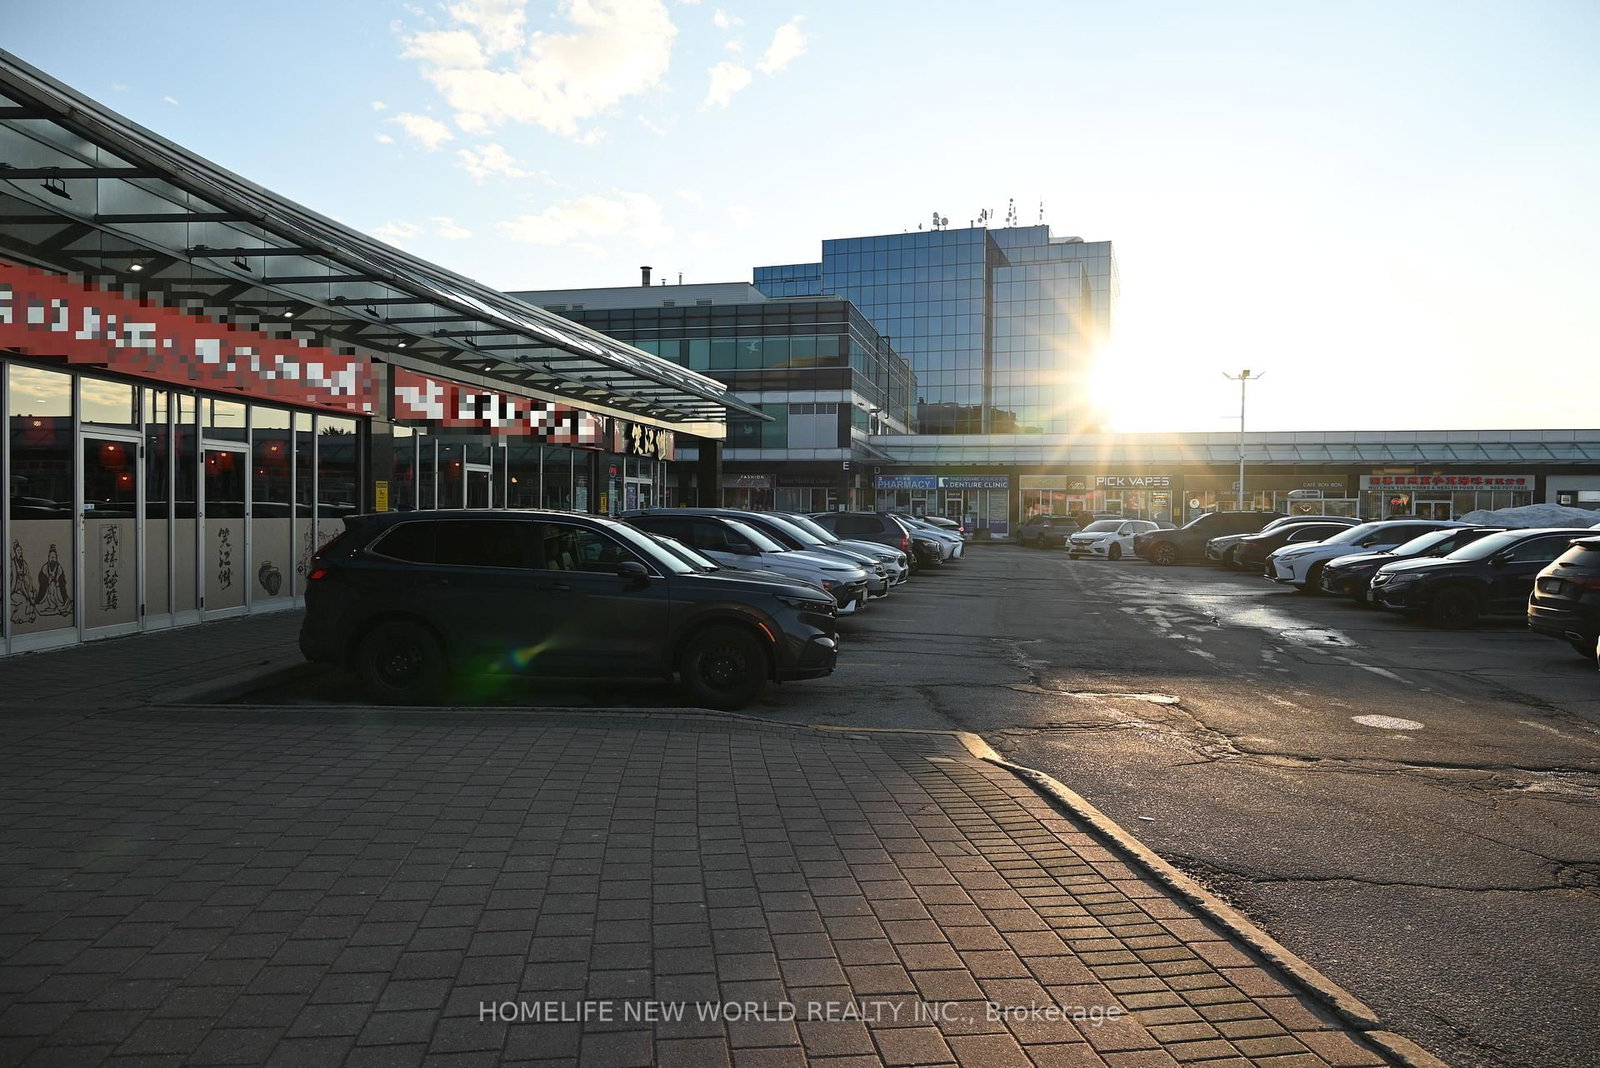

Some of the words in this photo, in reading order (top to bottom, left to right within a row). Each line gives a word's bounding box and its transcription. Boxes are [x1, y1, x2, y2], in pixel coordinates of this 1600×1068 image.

[842, 461, 849, 470] E
[874, 466, 881, 474] D
[877, 480, 931, 489] PHARMACY
[1096, 477, 1125, 486] PICK
[1128, 477, 1169, 486] VAPES
